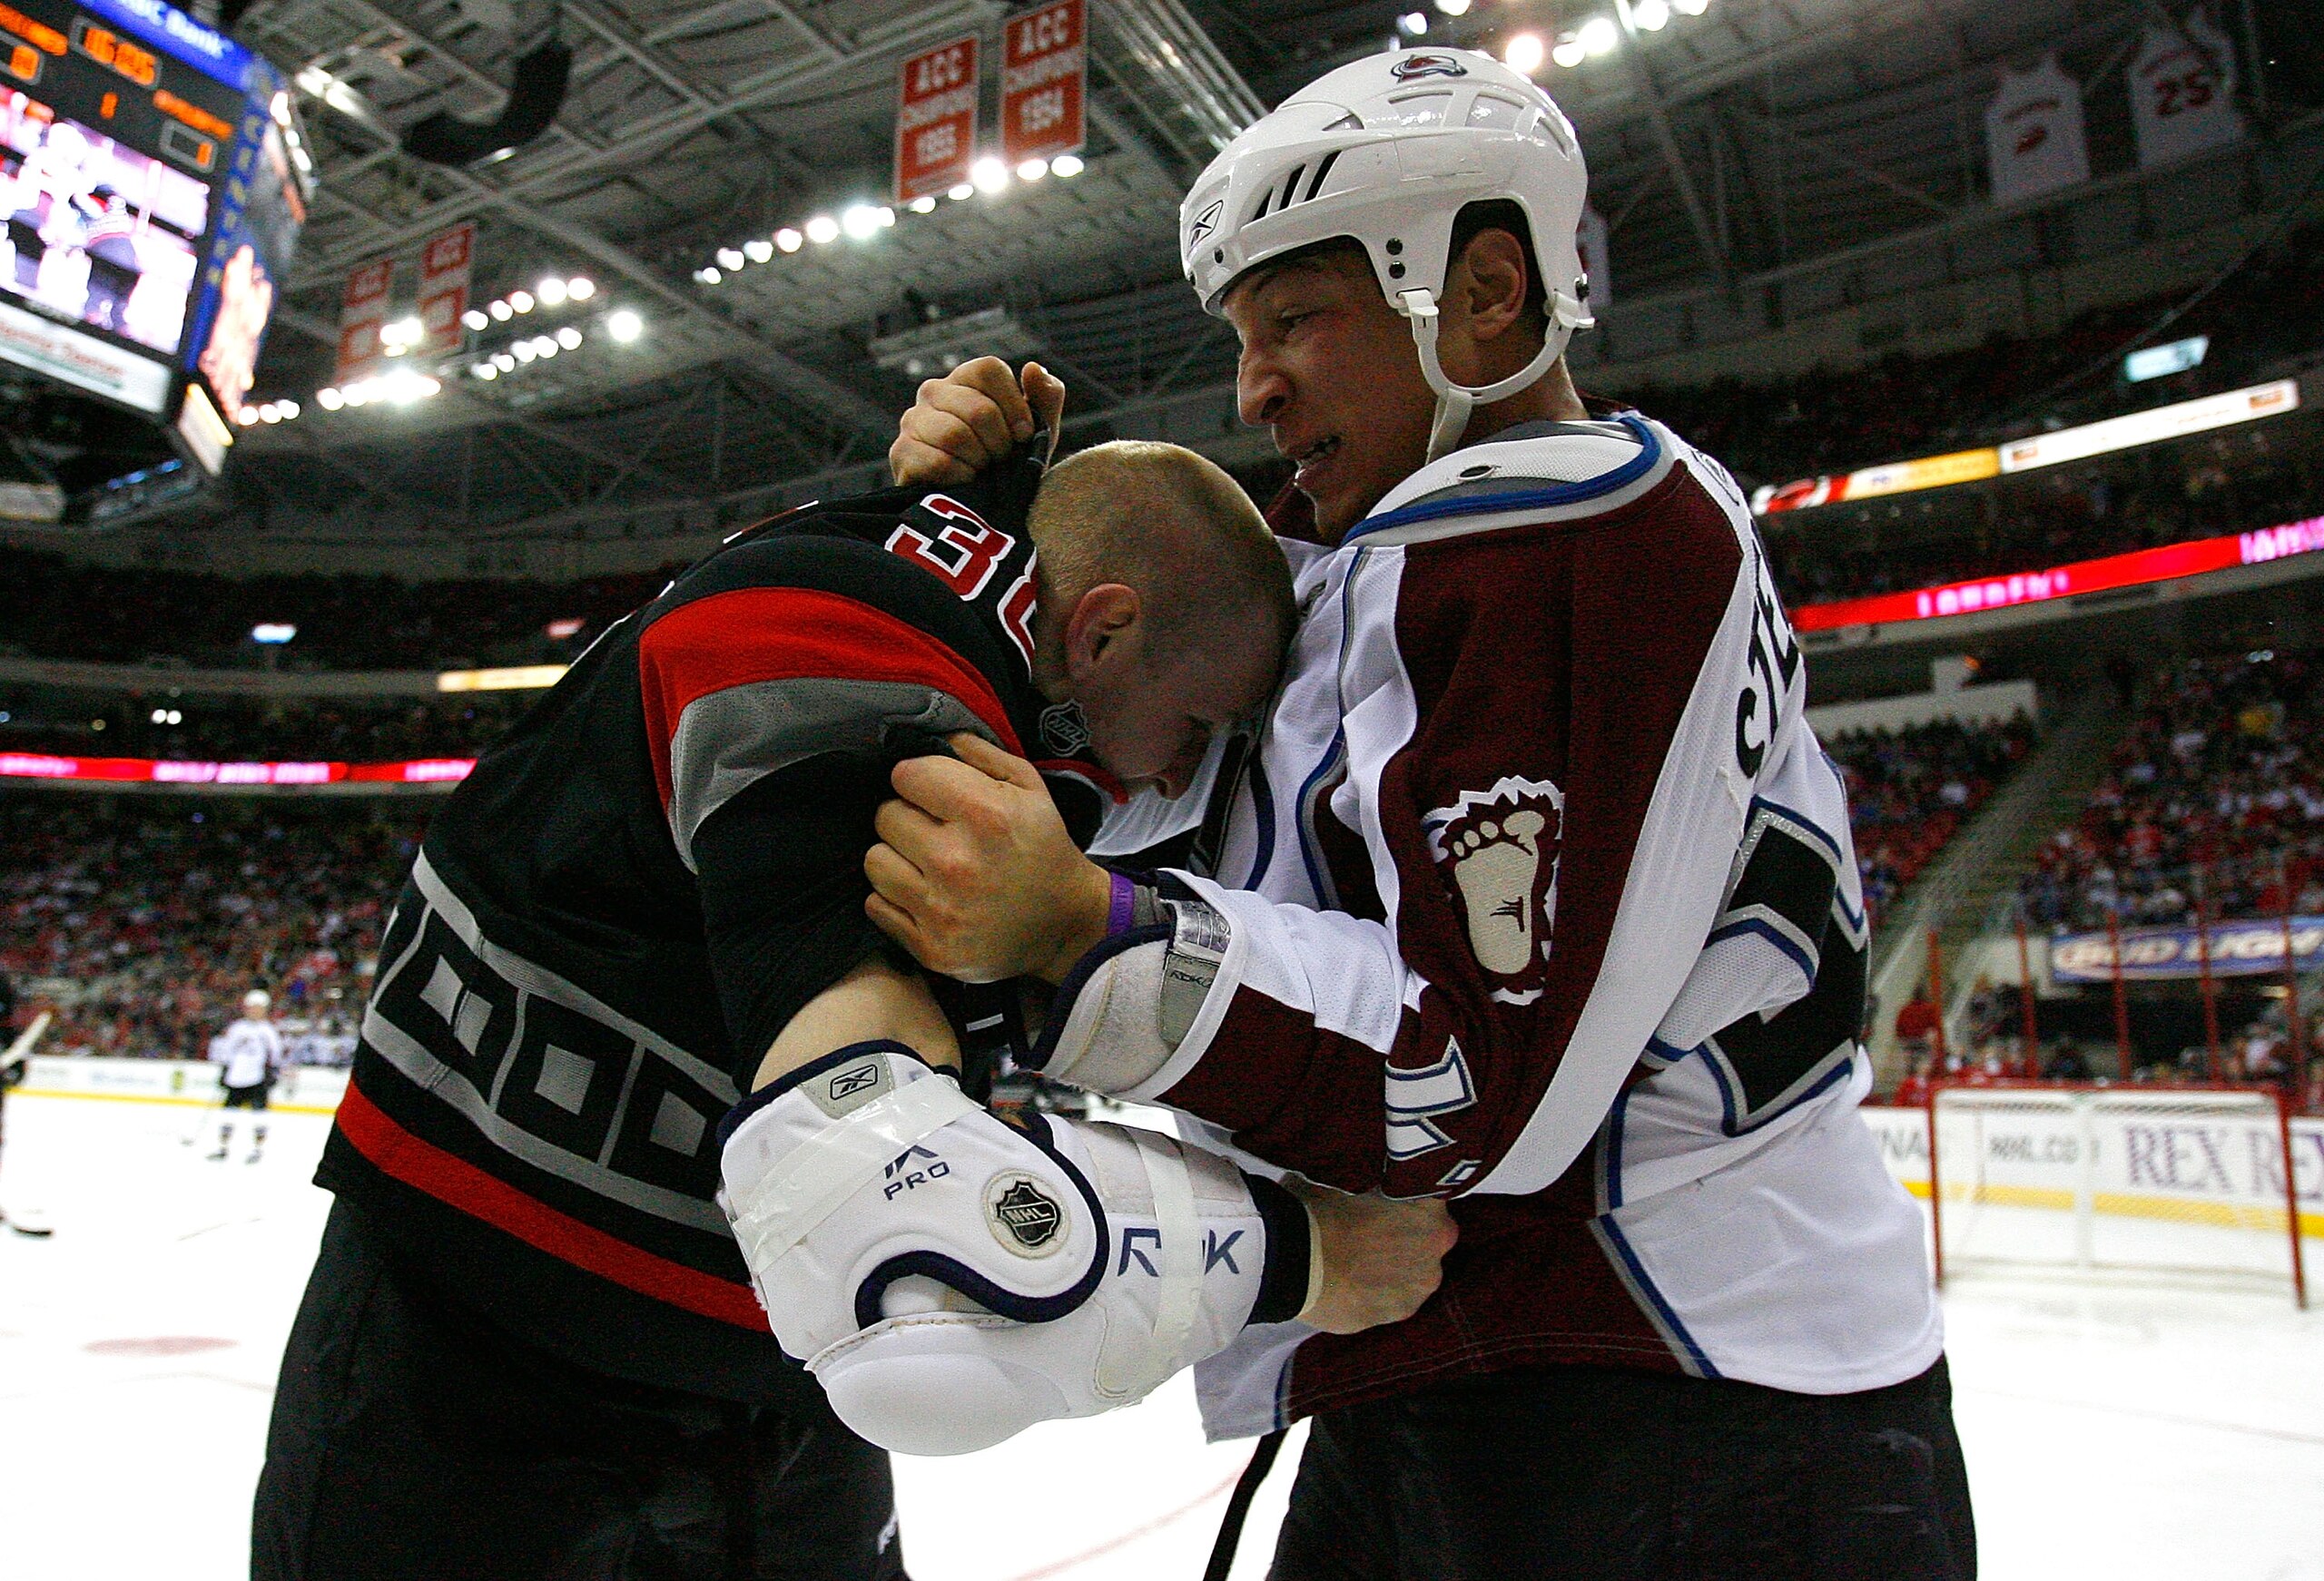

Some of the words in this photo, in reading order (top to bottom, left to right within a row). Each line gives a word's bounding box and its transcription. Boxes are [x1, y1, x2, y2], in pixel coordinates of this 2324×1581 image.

[1019, 8, 1069, 55] ACC
[917, 47, 962, 92] ACC
[883, 1161, 950, 1201] PRO
[2123, 1125, 2236, 1193] REX
[1005, 1206, 1051, 1223] NHL
[1117, 1227, 1246, 1278] RK
